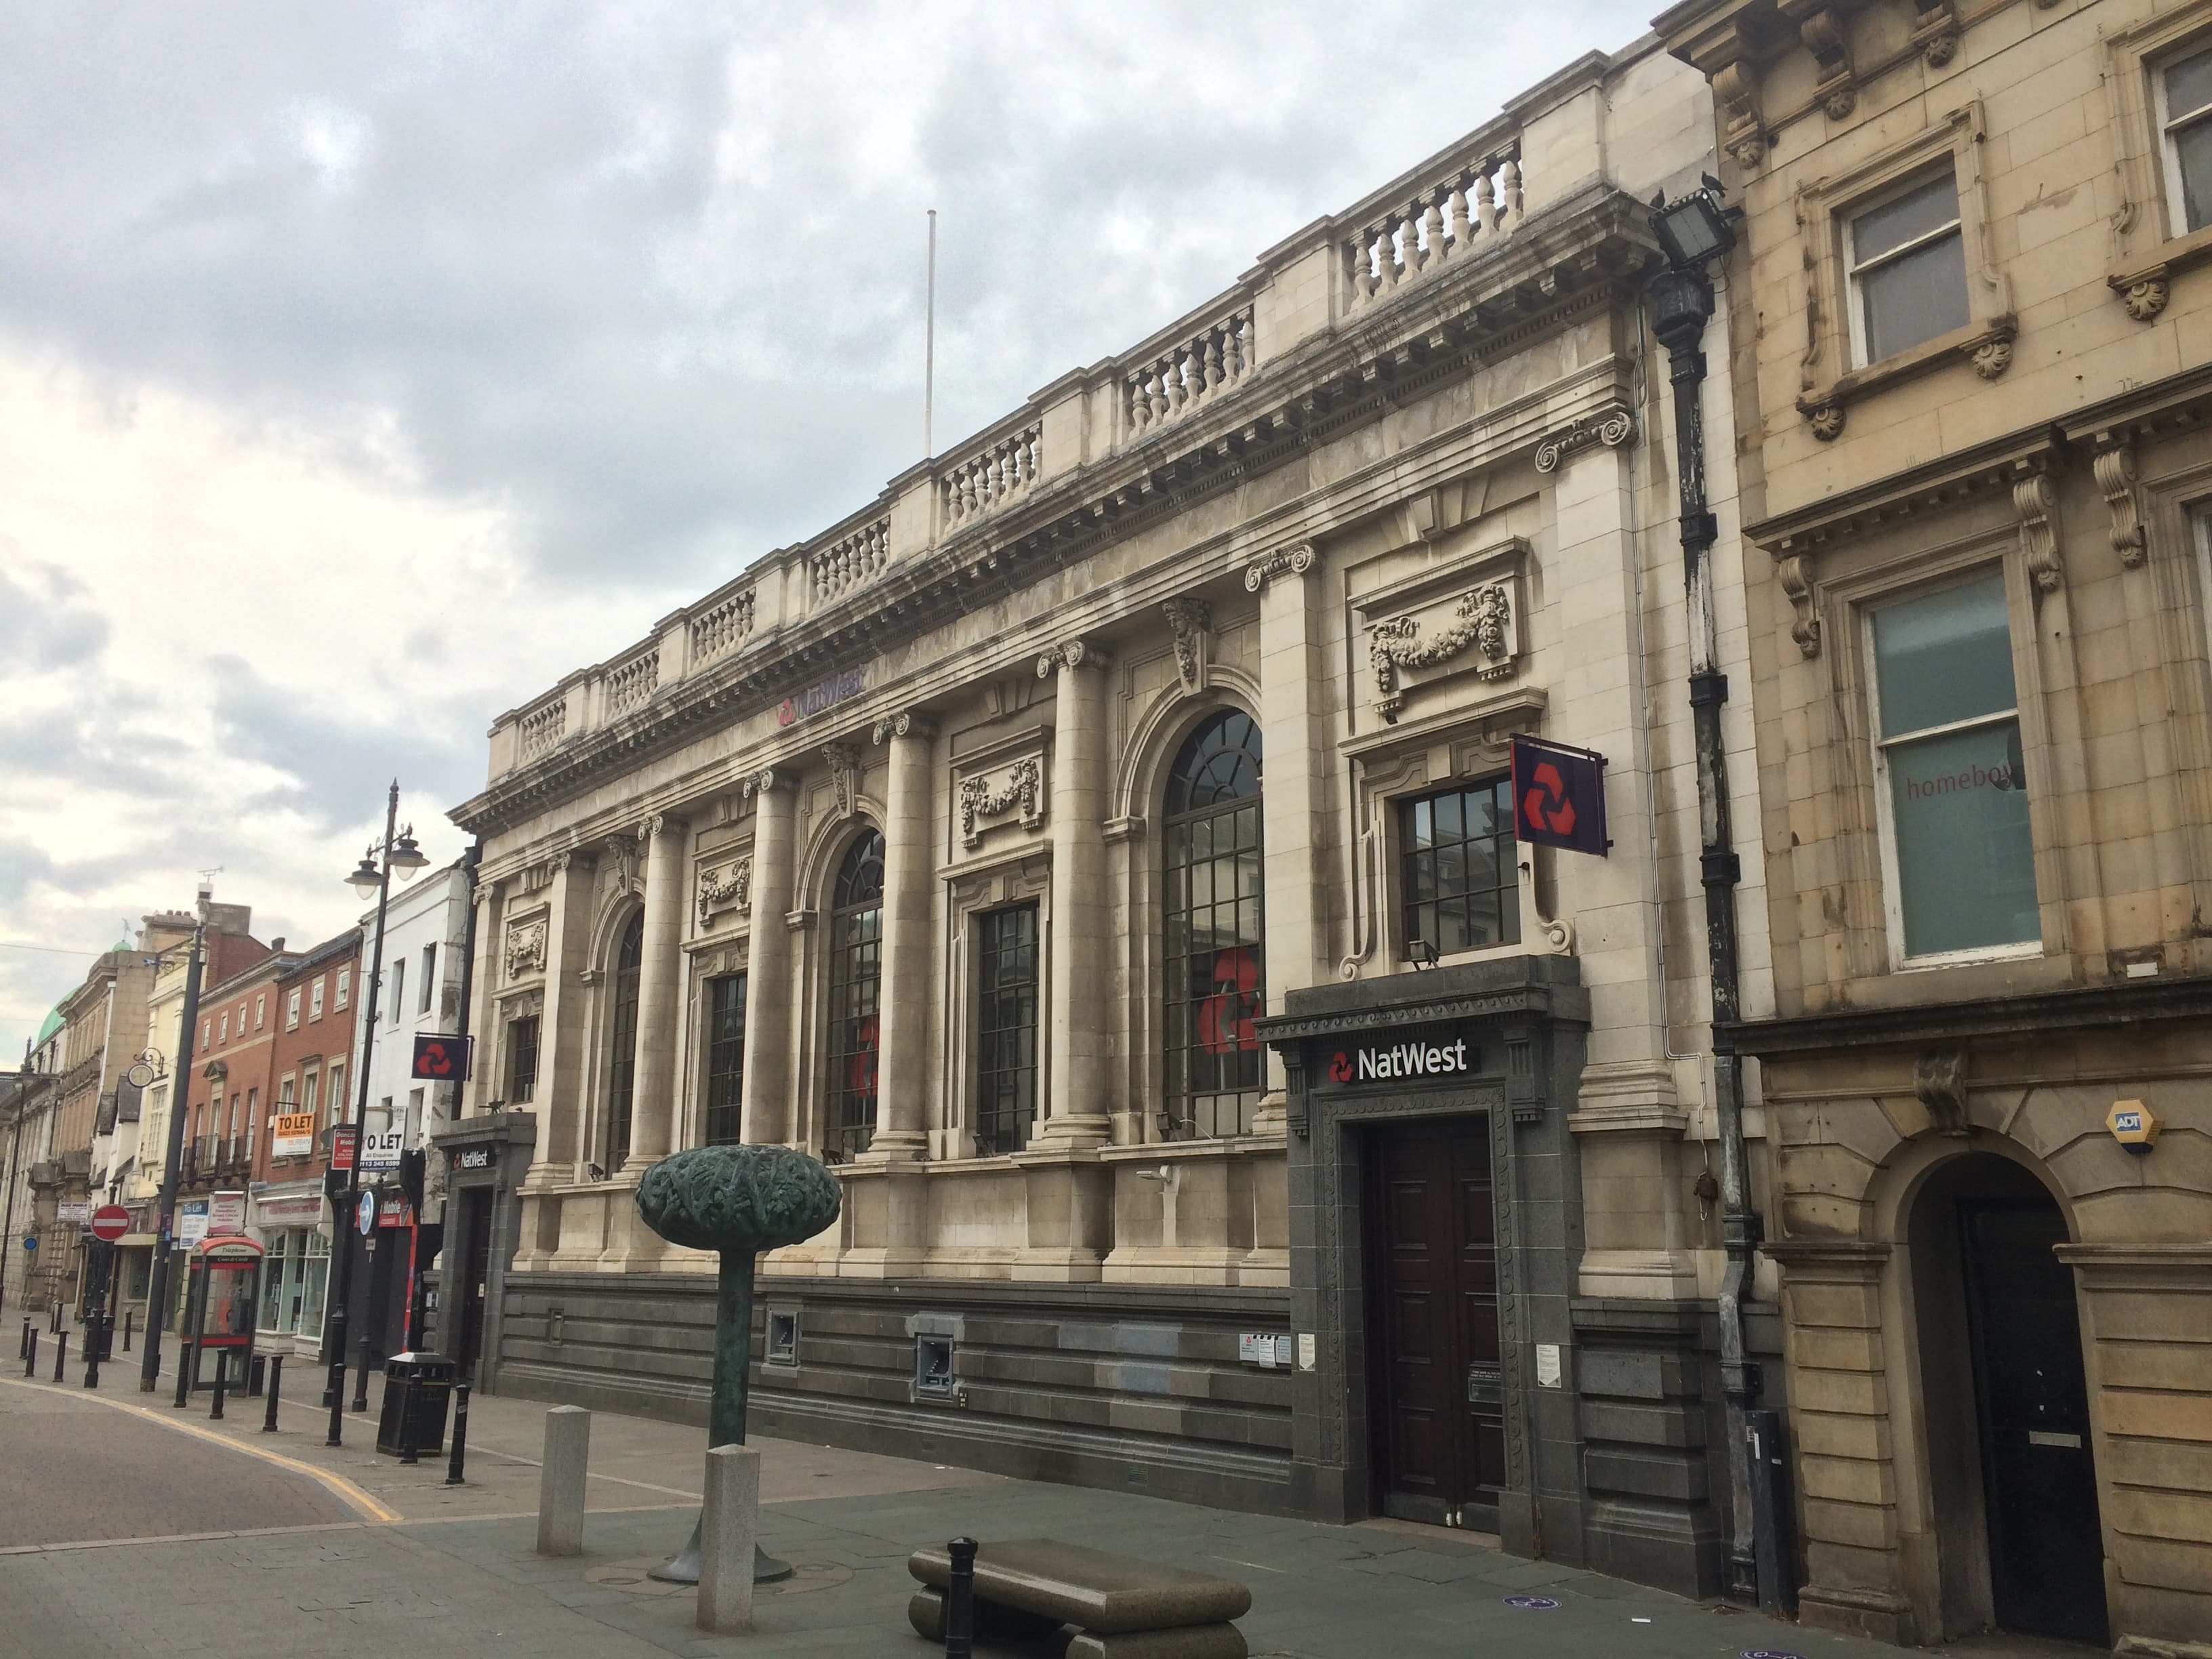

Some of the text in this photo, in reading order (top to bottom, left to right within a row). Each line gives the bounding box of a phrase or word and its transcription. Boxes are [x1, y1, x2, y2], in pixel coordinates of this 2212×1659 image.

[798, 668, 863, 719] NatWest
[1906, 764, 2014, 800] homeboy
[1358, 1038, 1467, 1080] NatWest
[279, 1115, 312, 1130] TO LET
[2116, 1115, 2140, 1128] ADT
[380, 1134, 402, 1150] LET
[461, 1149, 487, 1168] NatWest
[184, 1204, 202, 1212] To Let
